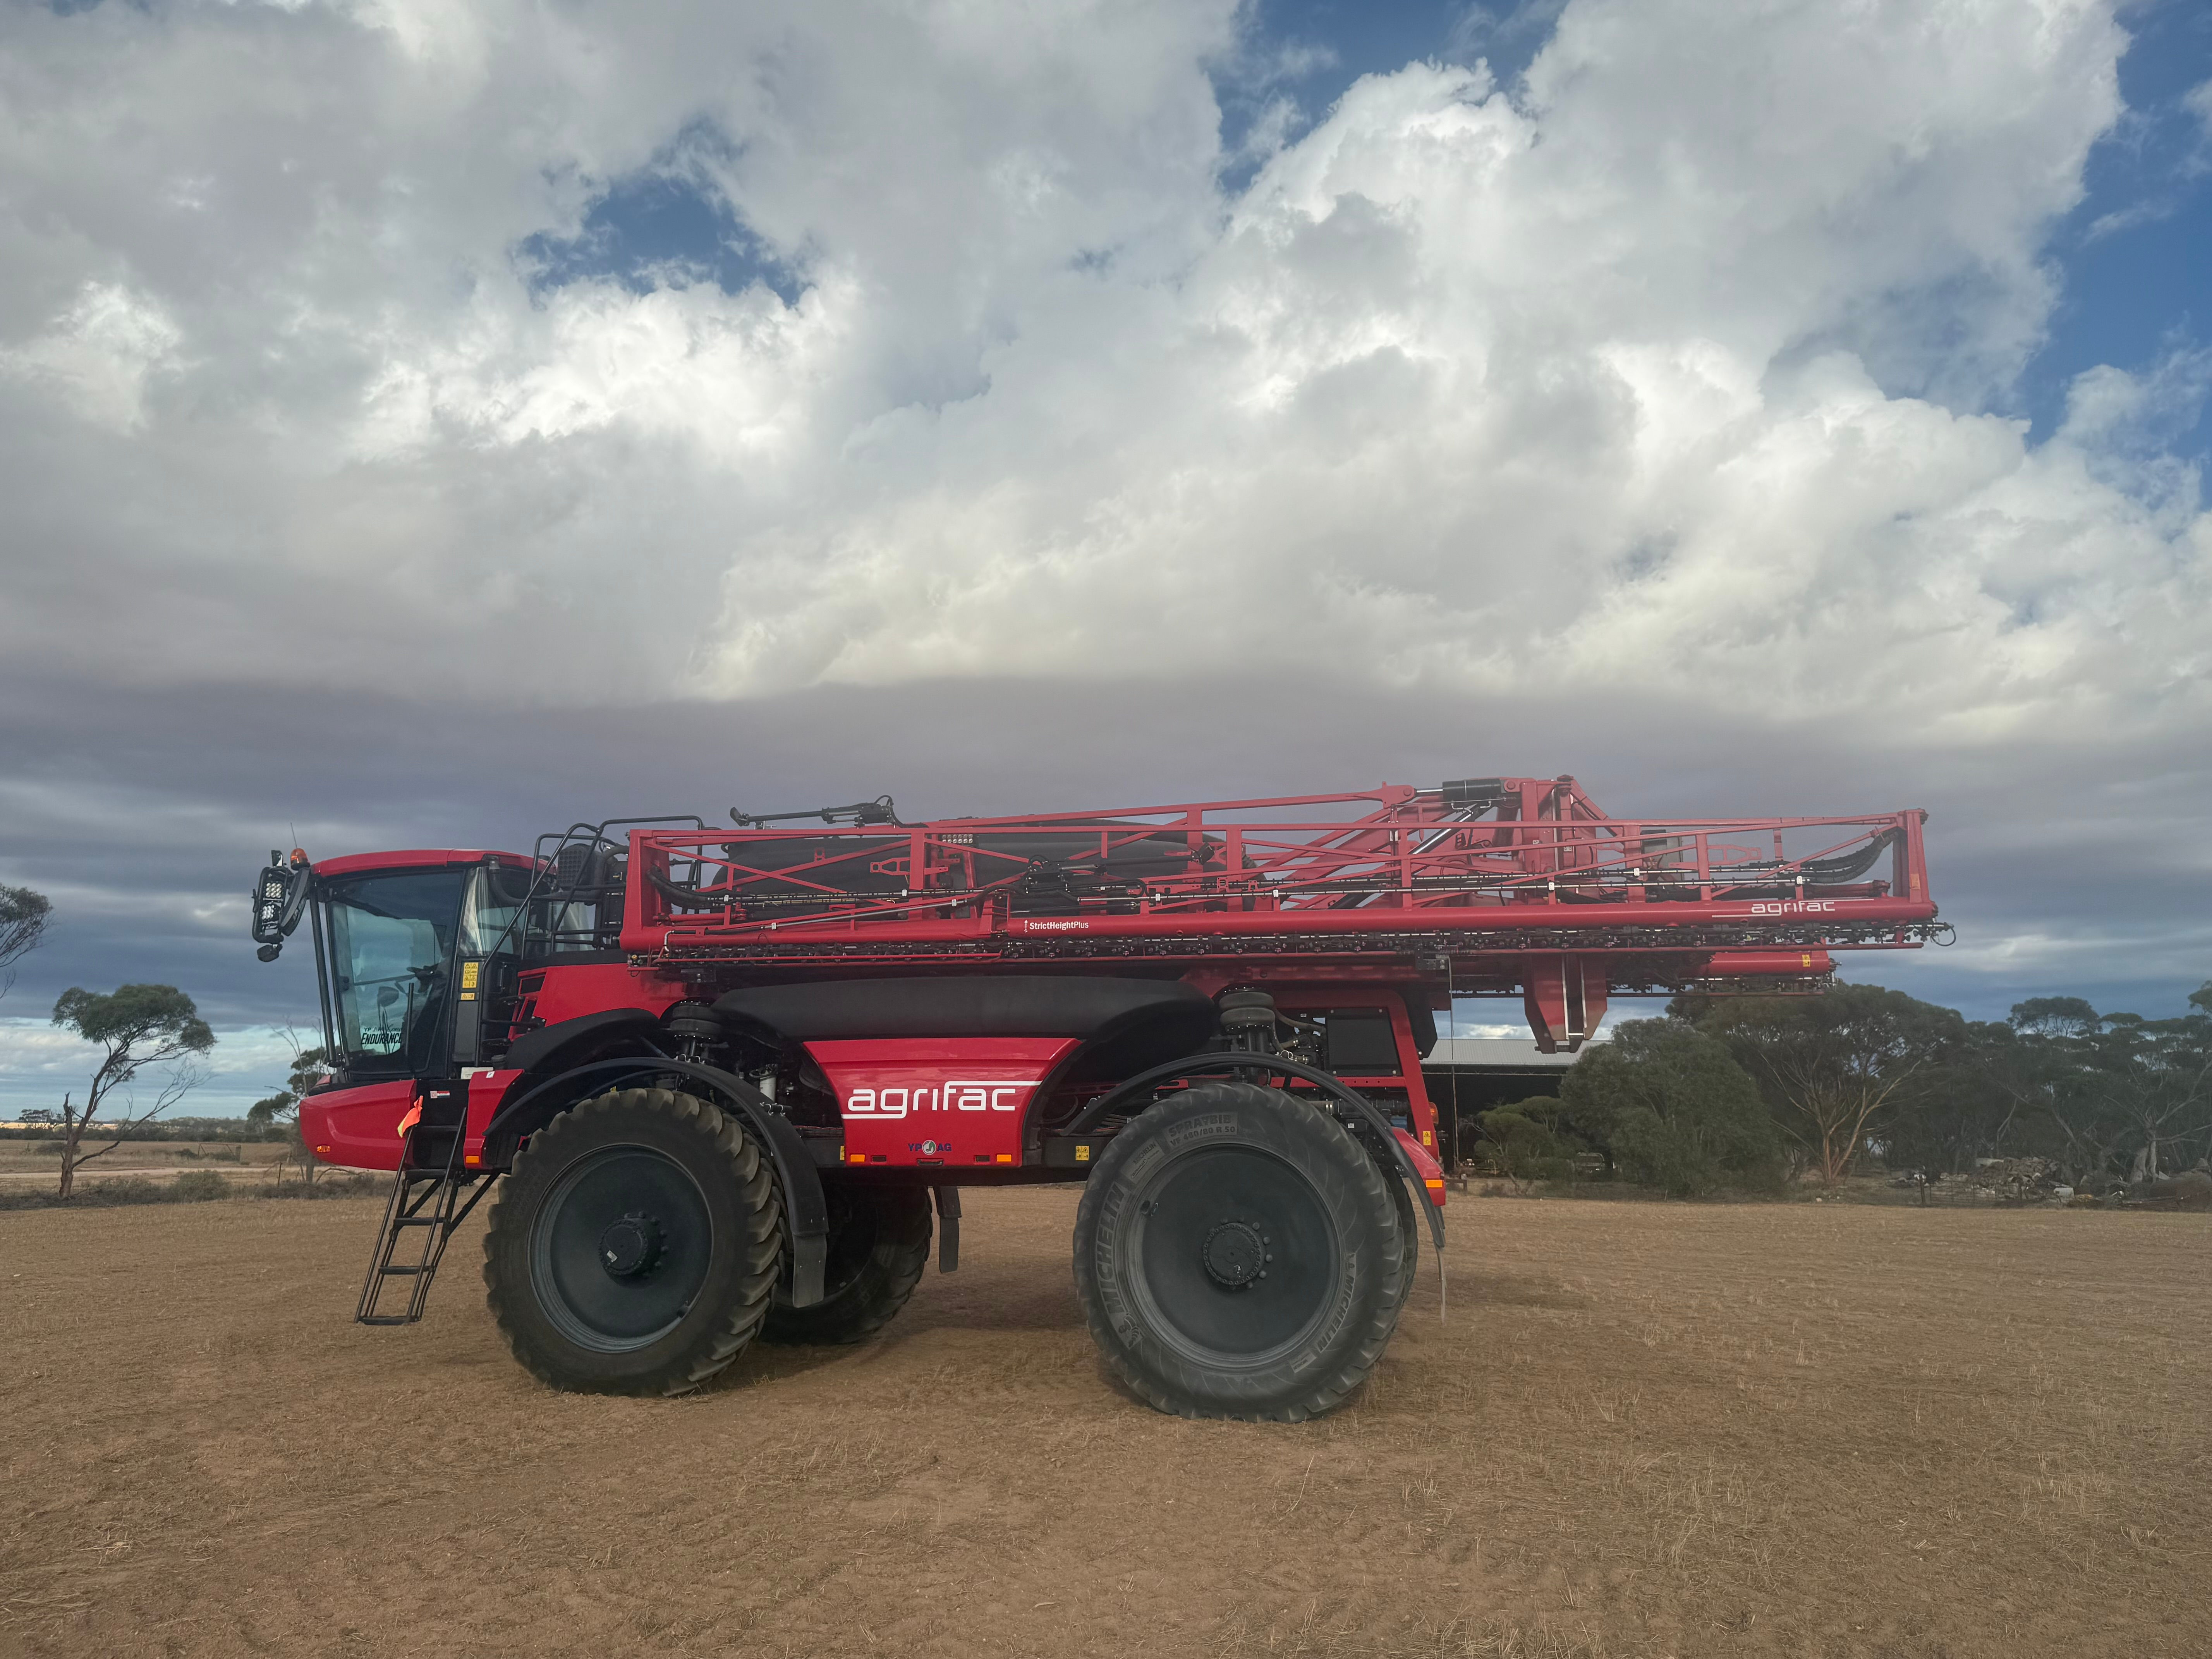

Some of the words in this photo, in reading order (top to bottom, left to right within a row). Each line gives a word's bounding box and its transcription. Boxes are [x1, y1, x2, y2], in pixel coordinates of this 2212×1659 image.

[1029, 921, 1089, 931] StrictHeightPlus
[361, 1033, 402, 1044] ENDURANCE
[842, 1081, 1043, 1119] agrifac
[1168, 1115, 1231, 1137] SPRAYBIB
[1170, 1137, 1181, 1146] VF
[1183, 1127, 1214, 1140] 480/80
[907, 1143, 922, 1151] YP
[936, 1143, 952, 1151] AG
[1133, 1142, 1156, 1165] CHELIN
[1096, 1182, 1125, 1314] MICHELIN
[1317, 1273, 1355, 1352] MICHELIN
